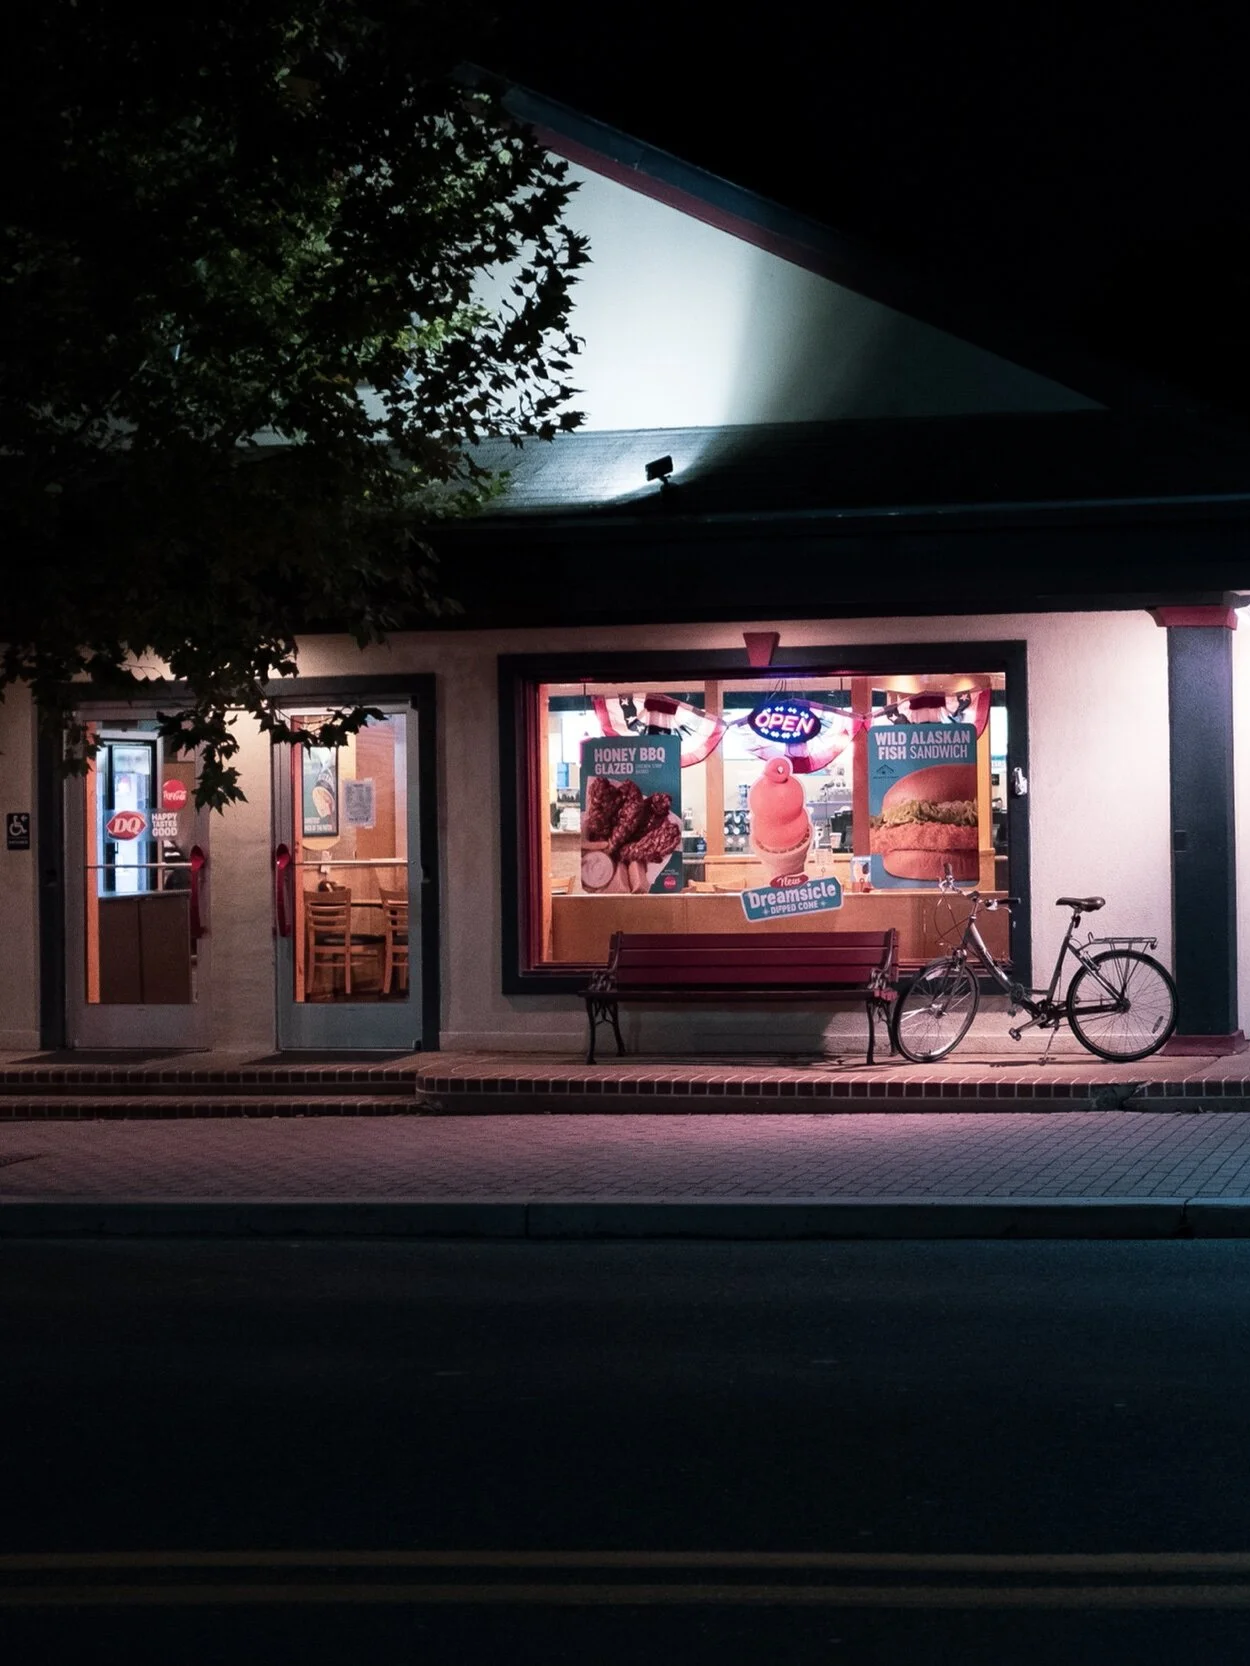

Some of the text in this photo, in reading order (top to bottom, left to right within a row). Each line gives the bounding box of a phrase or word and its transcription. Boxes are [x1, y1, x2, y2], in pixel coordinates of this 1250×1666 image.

[755, 712, 815, 734] OPEN
[874, 730, 970, 745] WILD ALASKAN
[594, 747, 666, 763] HONEY BBQ
[878, 744, 968, 760] FISH SANDWICH
[594, 763, 634, 775] GLAZED
[151, 813, 178, 821] HAPPY
[113, 817, 141, 835] DQ
[151, 828, 178, 837] GOOD
[776, 877, 802, 887] New
[748, 882, 837, 909] Dreamsicle
[770, 900, 819, 915] DIPPED CONE
